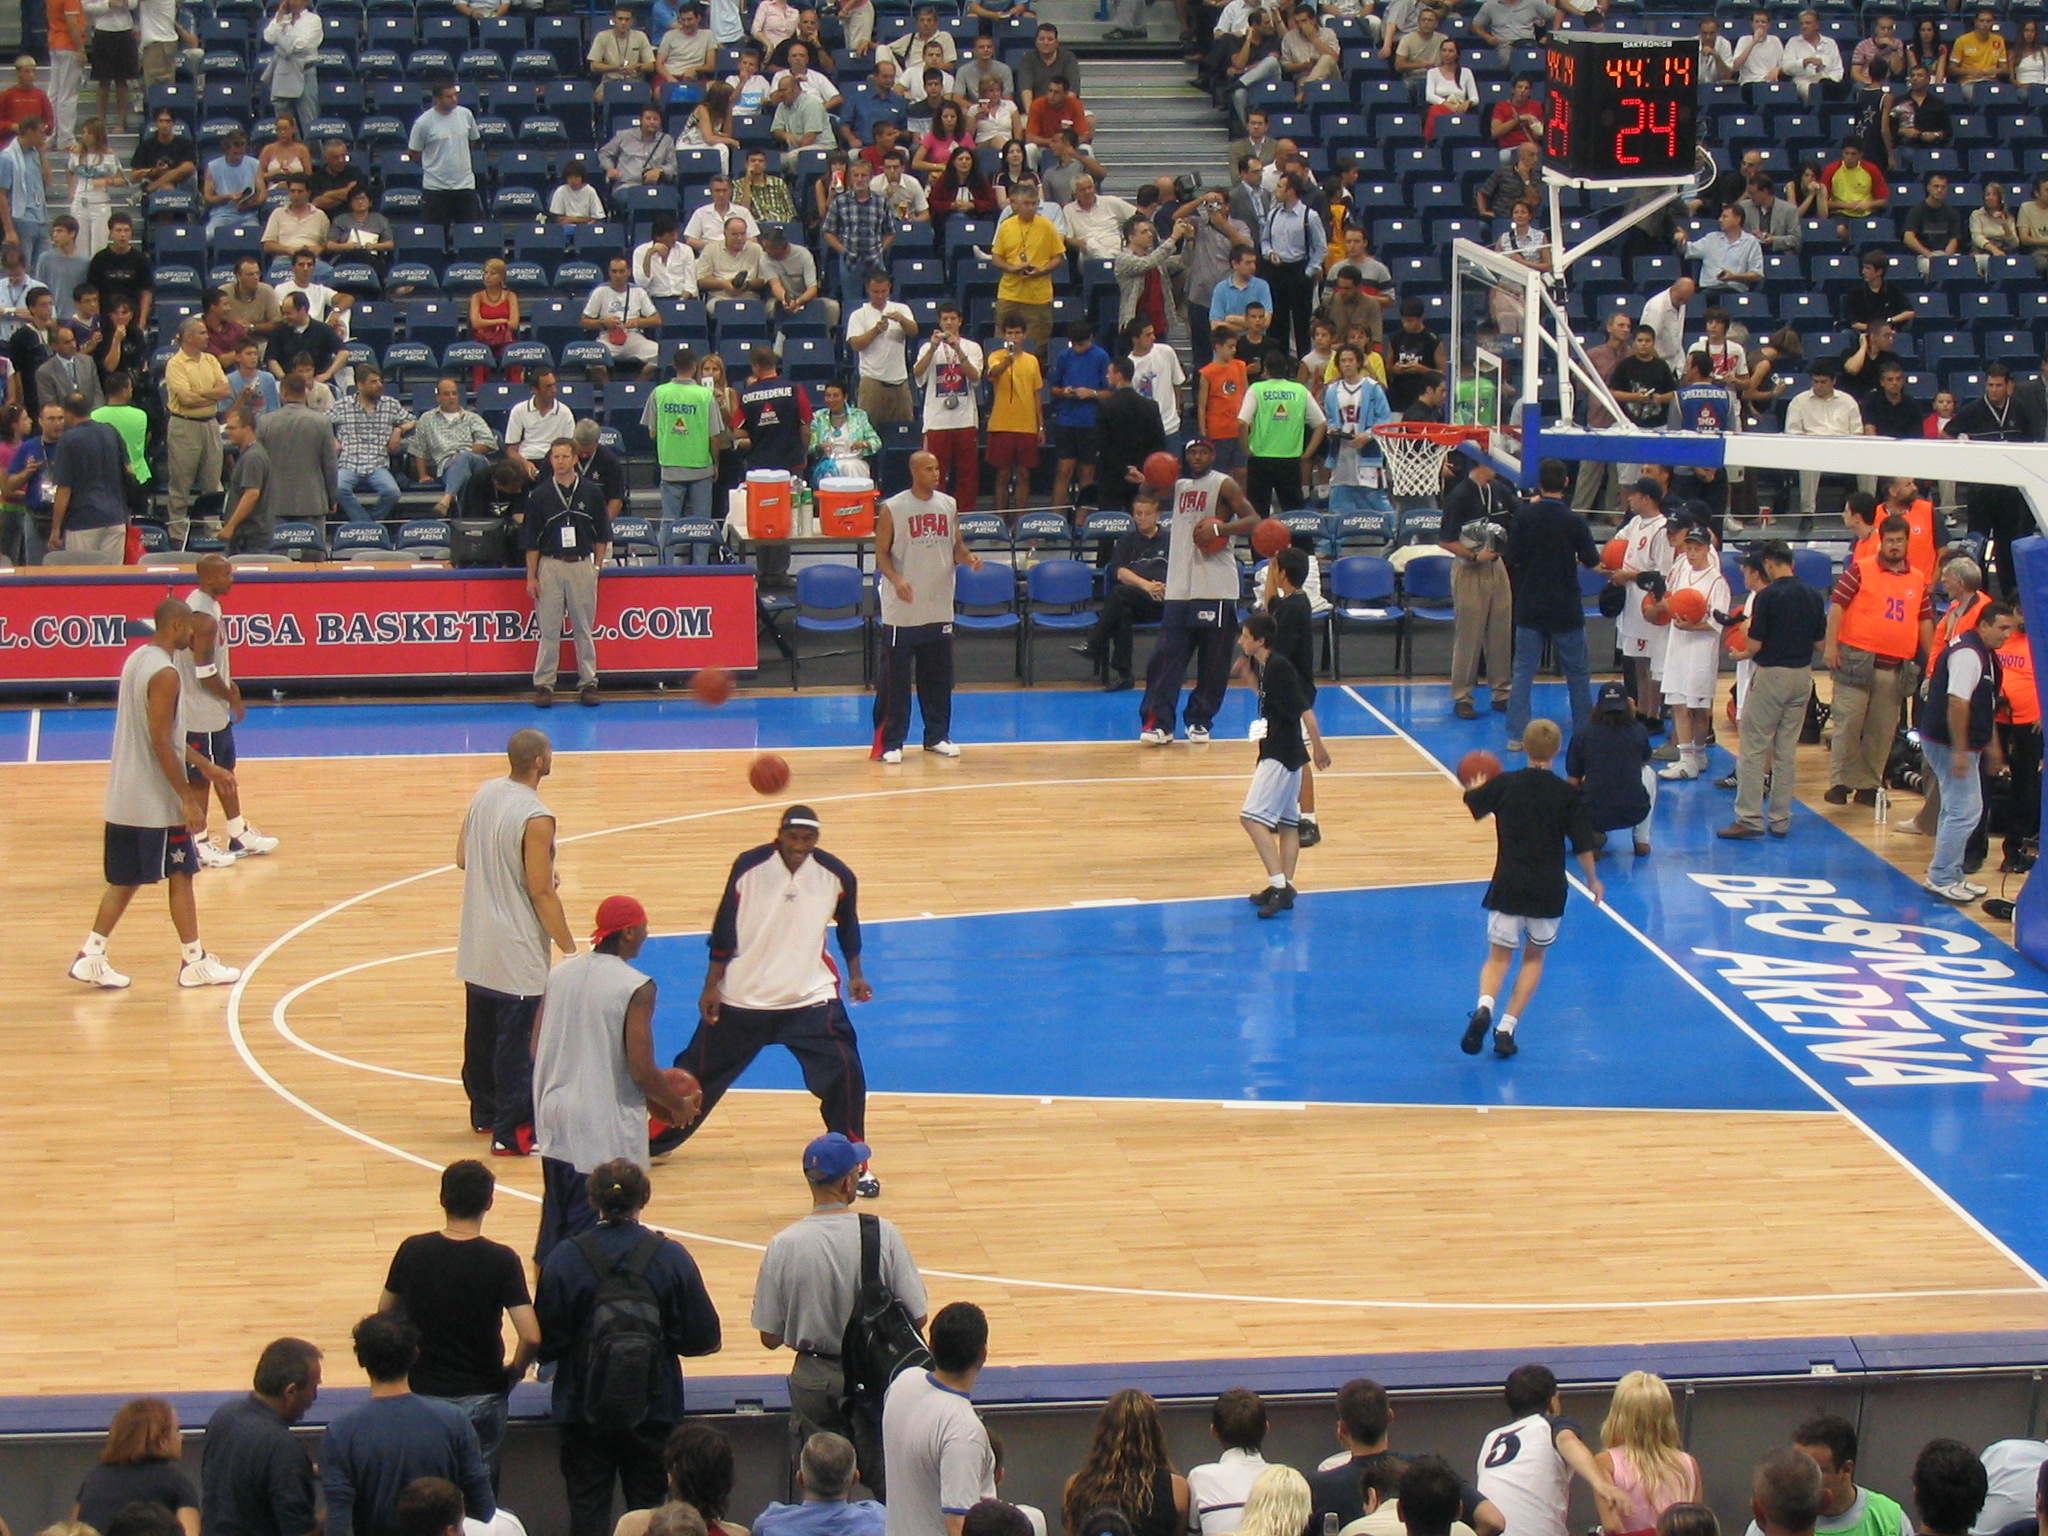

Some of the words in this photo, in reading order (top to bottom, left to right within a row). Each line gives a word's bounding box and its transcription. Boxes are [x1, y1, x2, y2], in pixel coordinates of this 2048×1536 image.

[1623, 40, 1672, 48] DAKTRONICS
[1616, 98, 1677, 164] 24
[1263, 390, 1296, 401] SECURITY
[663, 403, 698, 415] SECURITY
[1179, 490, 1208, 514] USA
[908, 513, 949, 538] USA
[959, 520, 1001, 531] BEOGRADSKA
[1023, 520, 1064, 530] BEOGRADSKA
[1089, 519, 1131, 529] BEOGRADSKA
[1343, 516, 1384, 526] BEOGRADSKA
[1359, 522, 1382, 530] ARENA
[340, 528, 383, 538] BEOGRADSKA
[404, 527, 447, 538] BEOGRADSKA
[612, 524, 648, 534] OGRADSKA
[672, 524, 715, 534] BEOGRADSKA
[356, 534, 380, 542] ARENA
[420, 533, 444, 541] ARENA
[1639, 536, 1648, 551] 9
[1885, 597, 1905, 622] 25
[223, 614, 305, 647] USA
[1686, 873, 2048, 1088] BEOGRADS
[1690, 947, 2000, 1087] ARENA
[1484, 1424, 1528, 1469] 5
